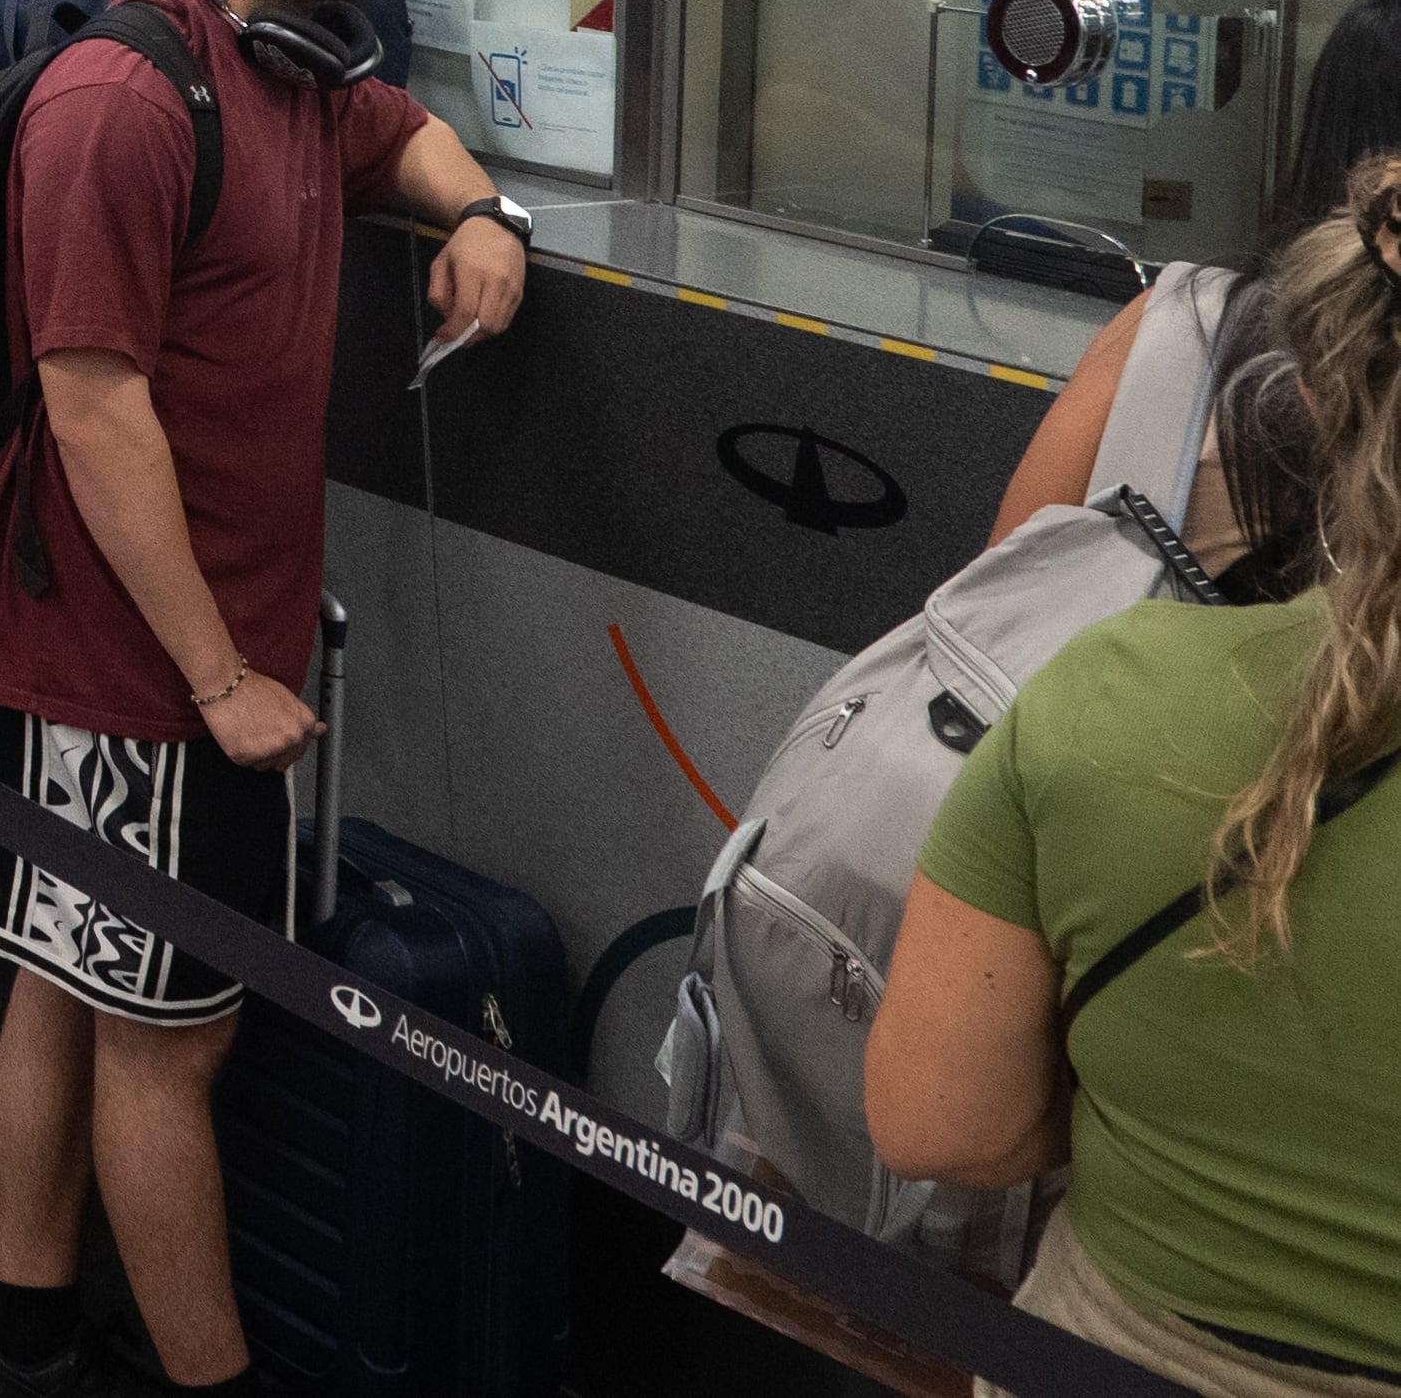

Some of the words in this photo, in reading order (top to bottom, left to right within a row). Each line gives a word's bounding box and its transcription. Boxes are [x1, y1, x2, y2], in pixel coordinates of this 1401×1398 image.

[390, 1013, 539, 1118] Aeropuertos
[538, 1089, 699, 1203] Argentina
[701, 1170, 785, 1244] 2000
